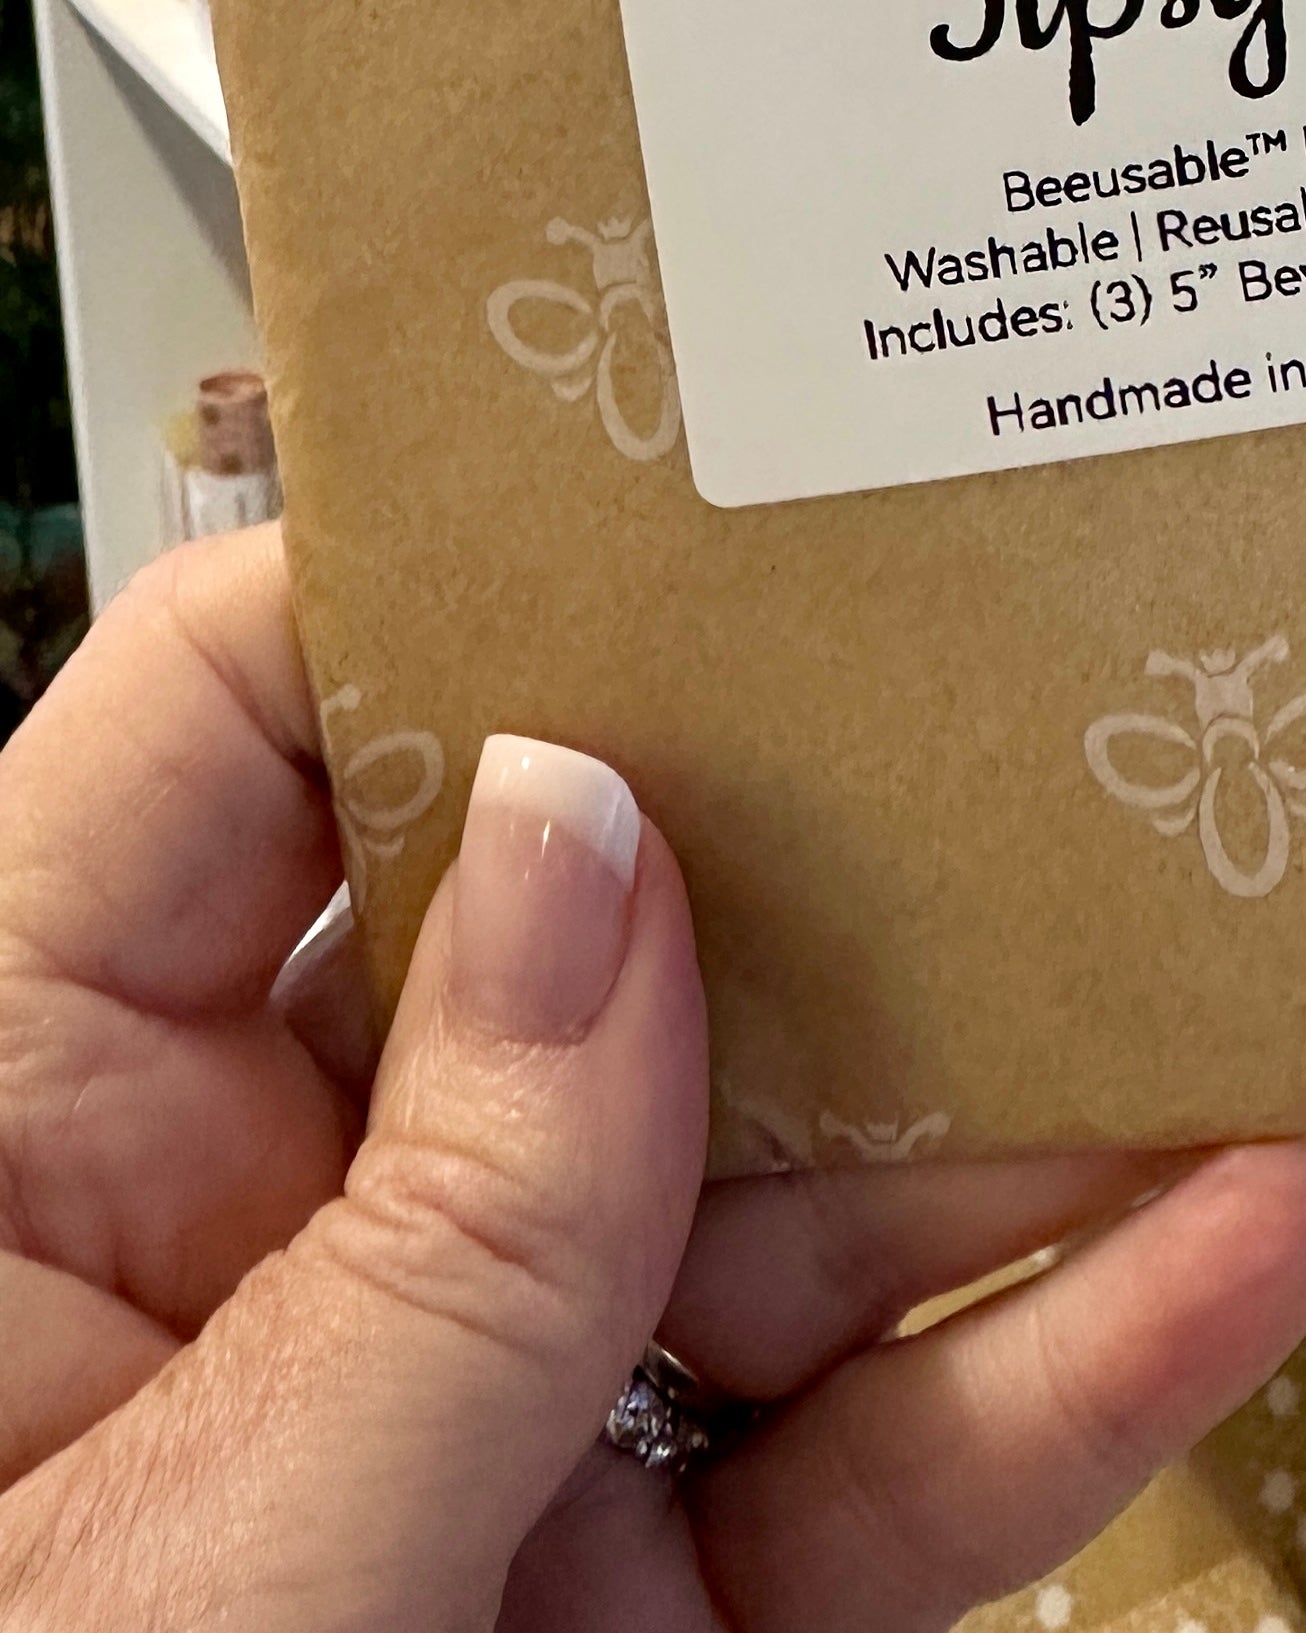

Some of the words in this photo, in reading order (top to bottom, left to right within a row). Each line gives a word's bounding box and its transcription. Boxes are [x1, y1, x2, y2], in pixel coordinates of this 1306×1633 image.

[882, 220, 1121, 293] Washable
[862, 296, 1075, 361] Includes:
[1089, 272, 1154, 332] (3)
[985, 358, 1253, 437] Handmade
